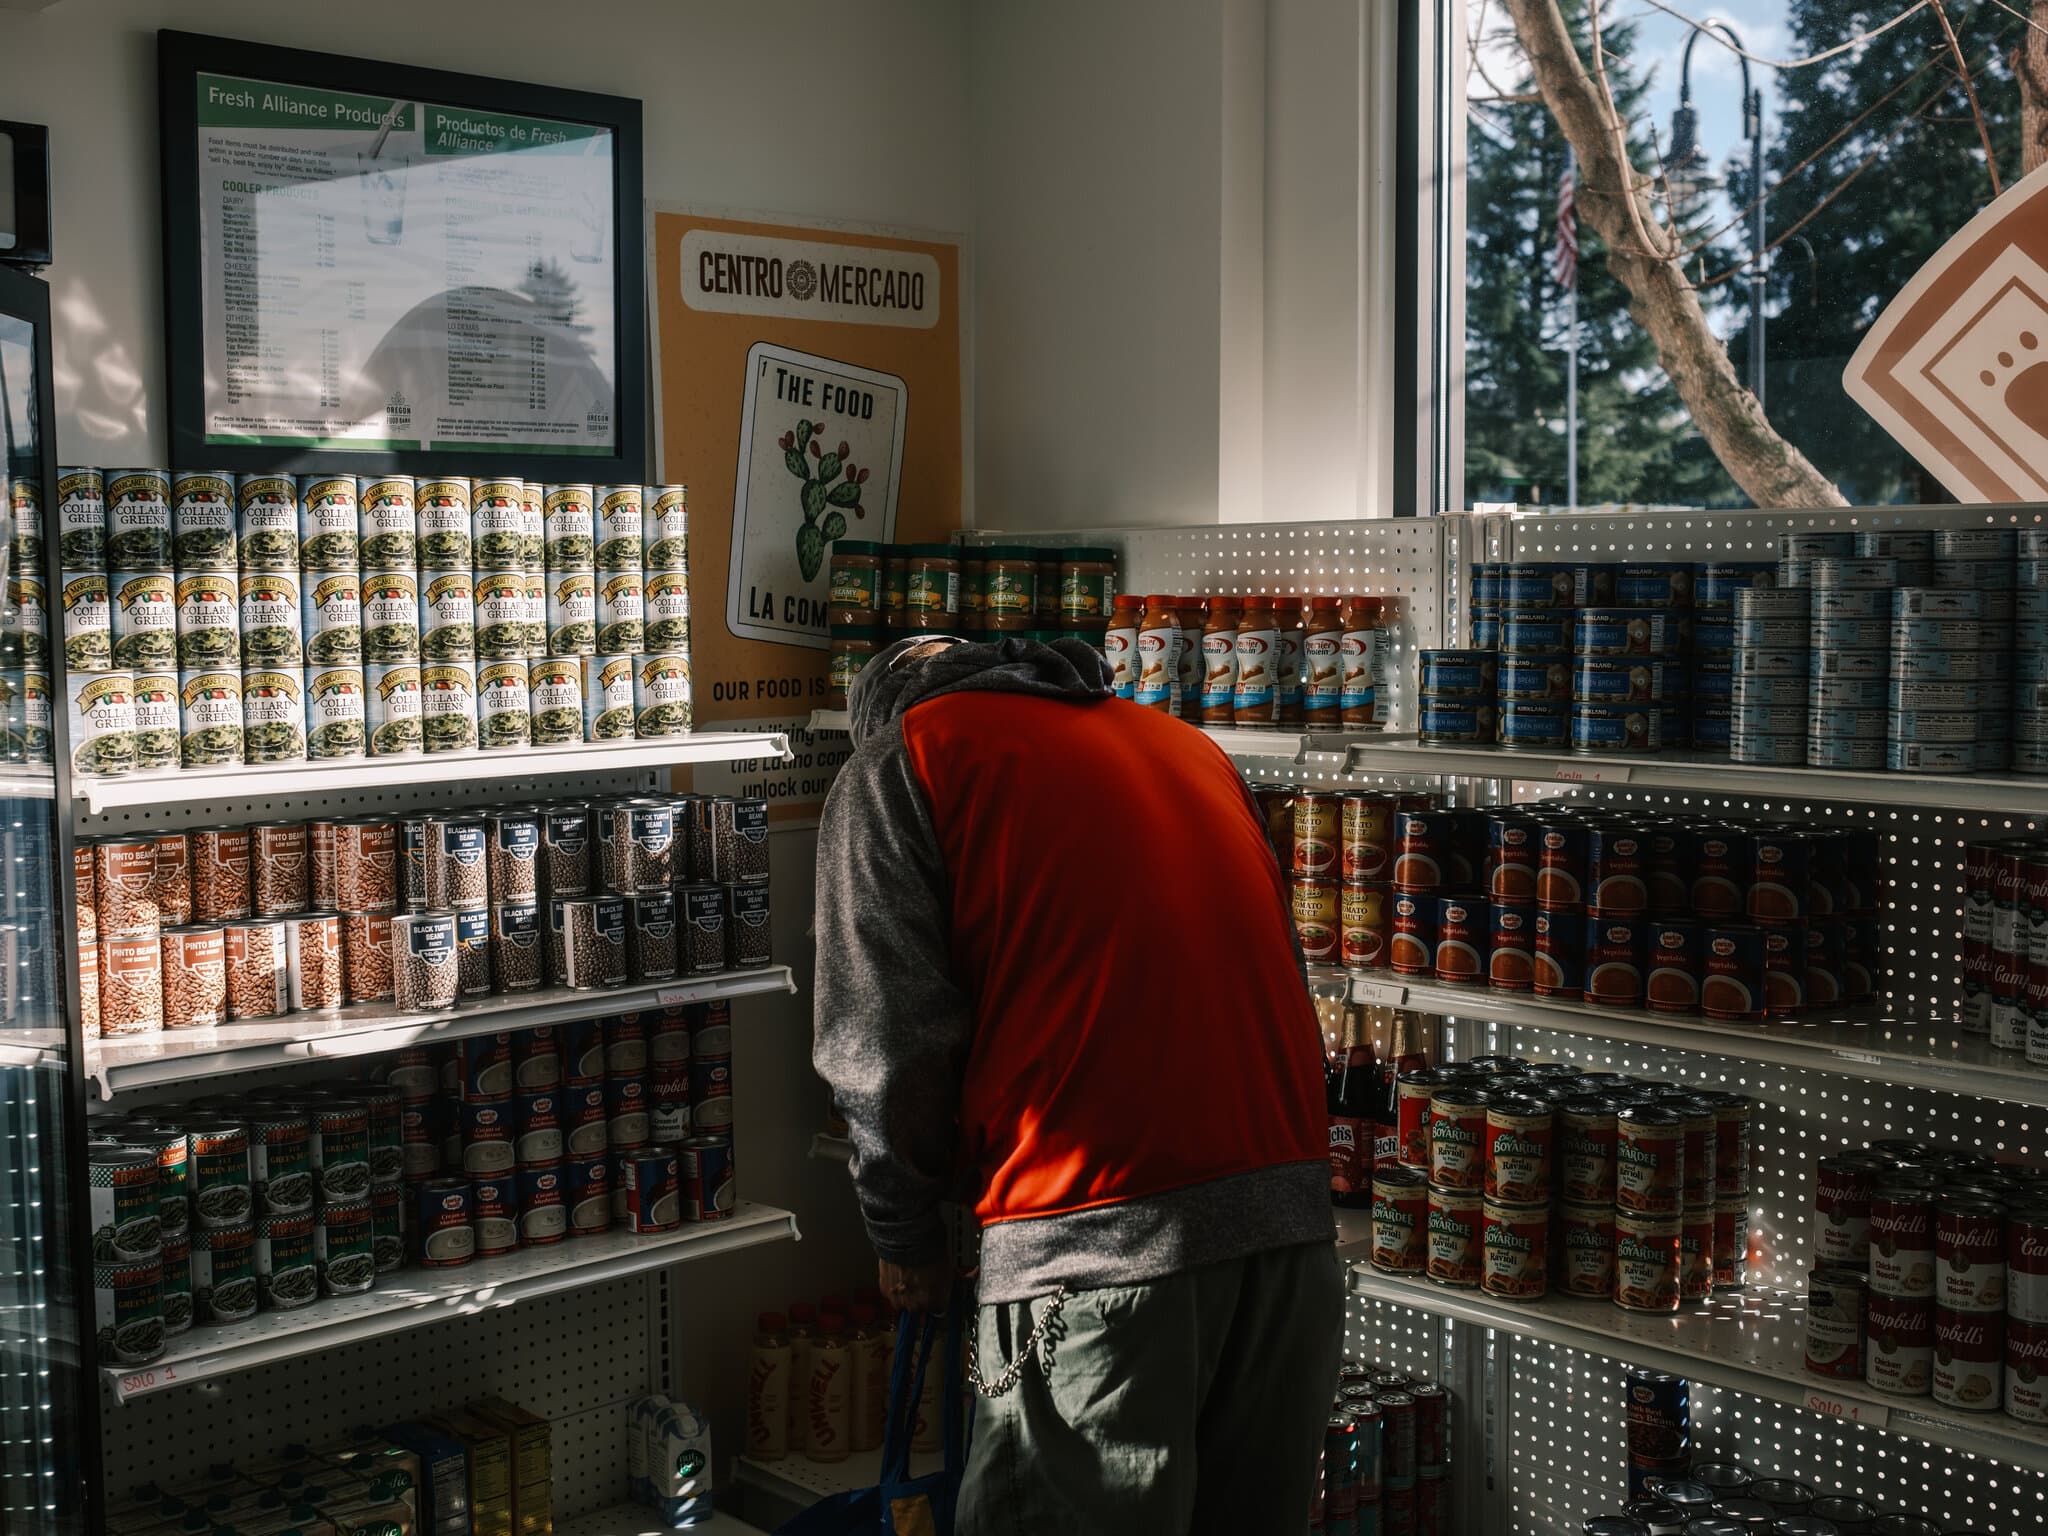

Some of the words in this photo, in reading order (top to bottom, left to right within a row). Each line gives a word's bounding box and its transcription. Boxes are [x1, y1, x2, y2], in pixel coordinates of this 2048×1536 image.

[209, 87, 254, 108] Fresh
[263, 94, 327, 118] Alliance
[335, 104, 405, 127] Products
[437, 114, 505, 137] Productos
[510, 125, 526, 141] de
[531, 127, 566, 144] Fresh
[437, 132, 494, 152] Alliance
[234, 150, 255, 161] specific
[258, 152, 280, 161] number
[223, 181, 262, 194] COOLER
[266, 184, 319, 201] PRODUCTS
[223, 197, 244, 205] DAIRY
[224, 263, 252, 271] CHEESE
[699, 251, 783, 299] CENTRO
[820, 263, 924, 311] MERCADO
[226, 314, 255, 323] OTHERS
[761, 360, 768, 377] 1
[776, 367, 813, 407] THE
[822, 383, 874, 421] FOOD
[386, 407, 411, 415] OREGON
[112, 480, 145, 494] MARGARET
[116, 506, 167, 516] COLLARD
[177, 506, 229, 516] COLLARD
[121, 515, 165, 526] GREENS
[183, 515, 227, 526] GREENS
[179, 581, 209, 595] MARGARET
[182, 605, 234, 616] COLLARD
[241, 605, 291, 616] COLLARD
[749, 586, 774, 621] LA
[784, 597, 829, 629] COM
[186, 615, 230, 625] GREENS
[1583, 614, 1610, 622] KIRKLAND
[713, 680, 750, 702] OUR
[756, 678, 802, 699] FOOD
[808, 678, 825, 697] IS
[731, 758, 757, 773] the
[763, 752, 813, 772] Latino
[742, 778, 795, 798] unlock
[801, 780, 828, 795] our
[634, 814, 653, 822] BLACK
[447, 827, 468, 835] BLACK
[503, 822, 524, 830] BLACK
[1295, 825, 1317, 833] SAUCE
[267, 832, 287, 842] PINTO
[362, 832, 382, 840] PINTO
[162, 842, 183, 852] BEANS
[220, 838, 240, 847] PINTO
[111, 852, 133, 861] PINTO
[413, 926, 433, 934] BLACK
[426, 932, 445, 941] BEANS
[112, 948, 136, 957] PINTO
[1432, 1126, 1480, 1146] BOYARDEE
[1497, 1133, 1514, 1144] Chef
[1438, 1147, 1465, 1159] Ravioli
[1493, 1141, 1544, 1159] BOYARDEE
[1502, 1161, 1532, 1172] Ravioli
[1486, 1224, 1501, 1235] Chef
[1871, 1214, 1928, 1234] ampbell's
[1824, 1229, 1852, 1240] Chicken
[1432, 1238, 1458, 1250] Ravioli
[1484, 1231, 1532, 1252] BOYARDEE
[1825, 1237, 1850, 1249] Noodle
[1490, 1252, 1518, 1264] Ravioli
[1617, 1243, 1668, 1264] BOYARDEE
[1624, 1265, 1653, 1278] Ravioli
[1875, 1261, 1902, 1273] Chicken
[1876, 1270, 1900, 1281] Noodle
[1946, 1277, 1975, 1289] Chicken
[1948, 1285, 1974, 1297] Noodle
[1950, 1298, 1970, 1308] SOUP
[1869, 1311, 1927, 1331] ampbell's
[1816, 1323, 1857, 1335] MUSHROOM
[1875, 1357, 1902, 1369] Chicken
[1875, 1366, 1900, 1378] Noodle
[123, 1372, 155, 1392] SOLO
[166, 1367, 176, 1380] 1
[750, 1357, 777, 1444] UNWELL
[810, 1359, 841, 1447] UNWELL
[2014, 1395, 2040, 1408] Noodle
[1851, 1407, 1859, 1419] 1
